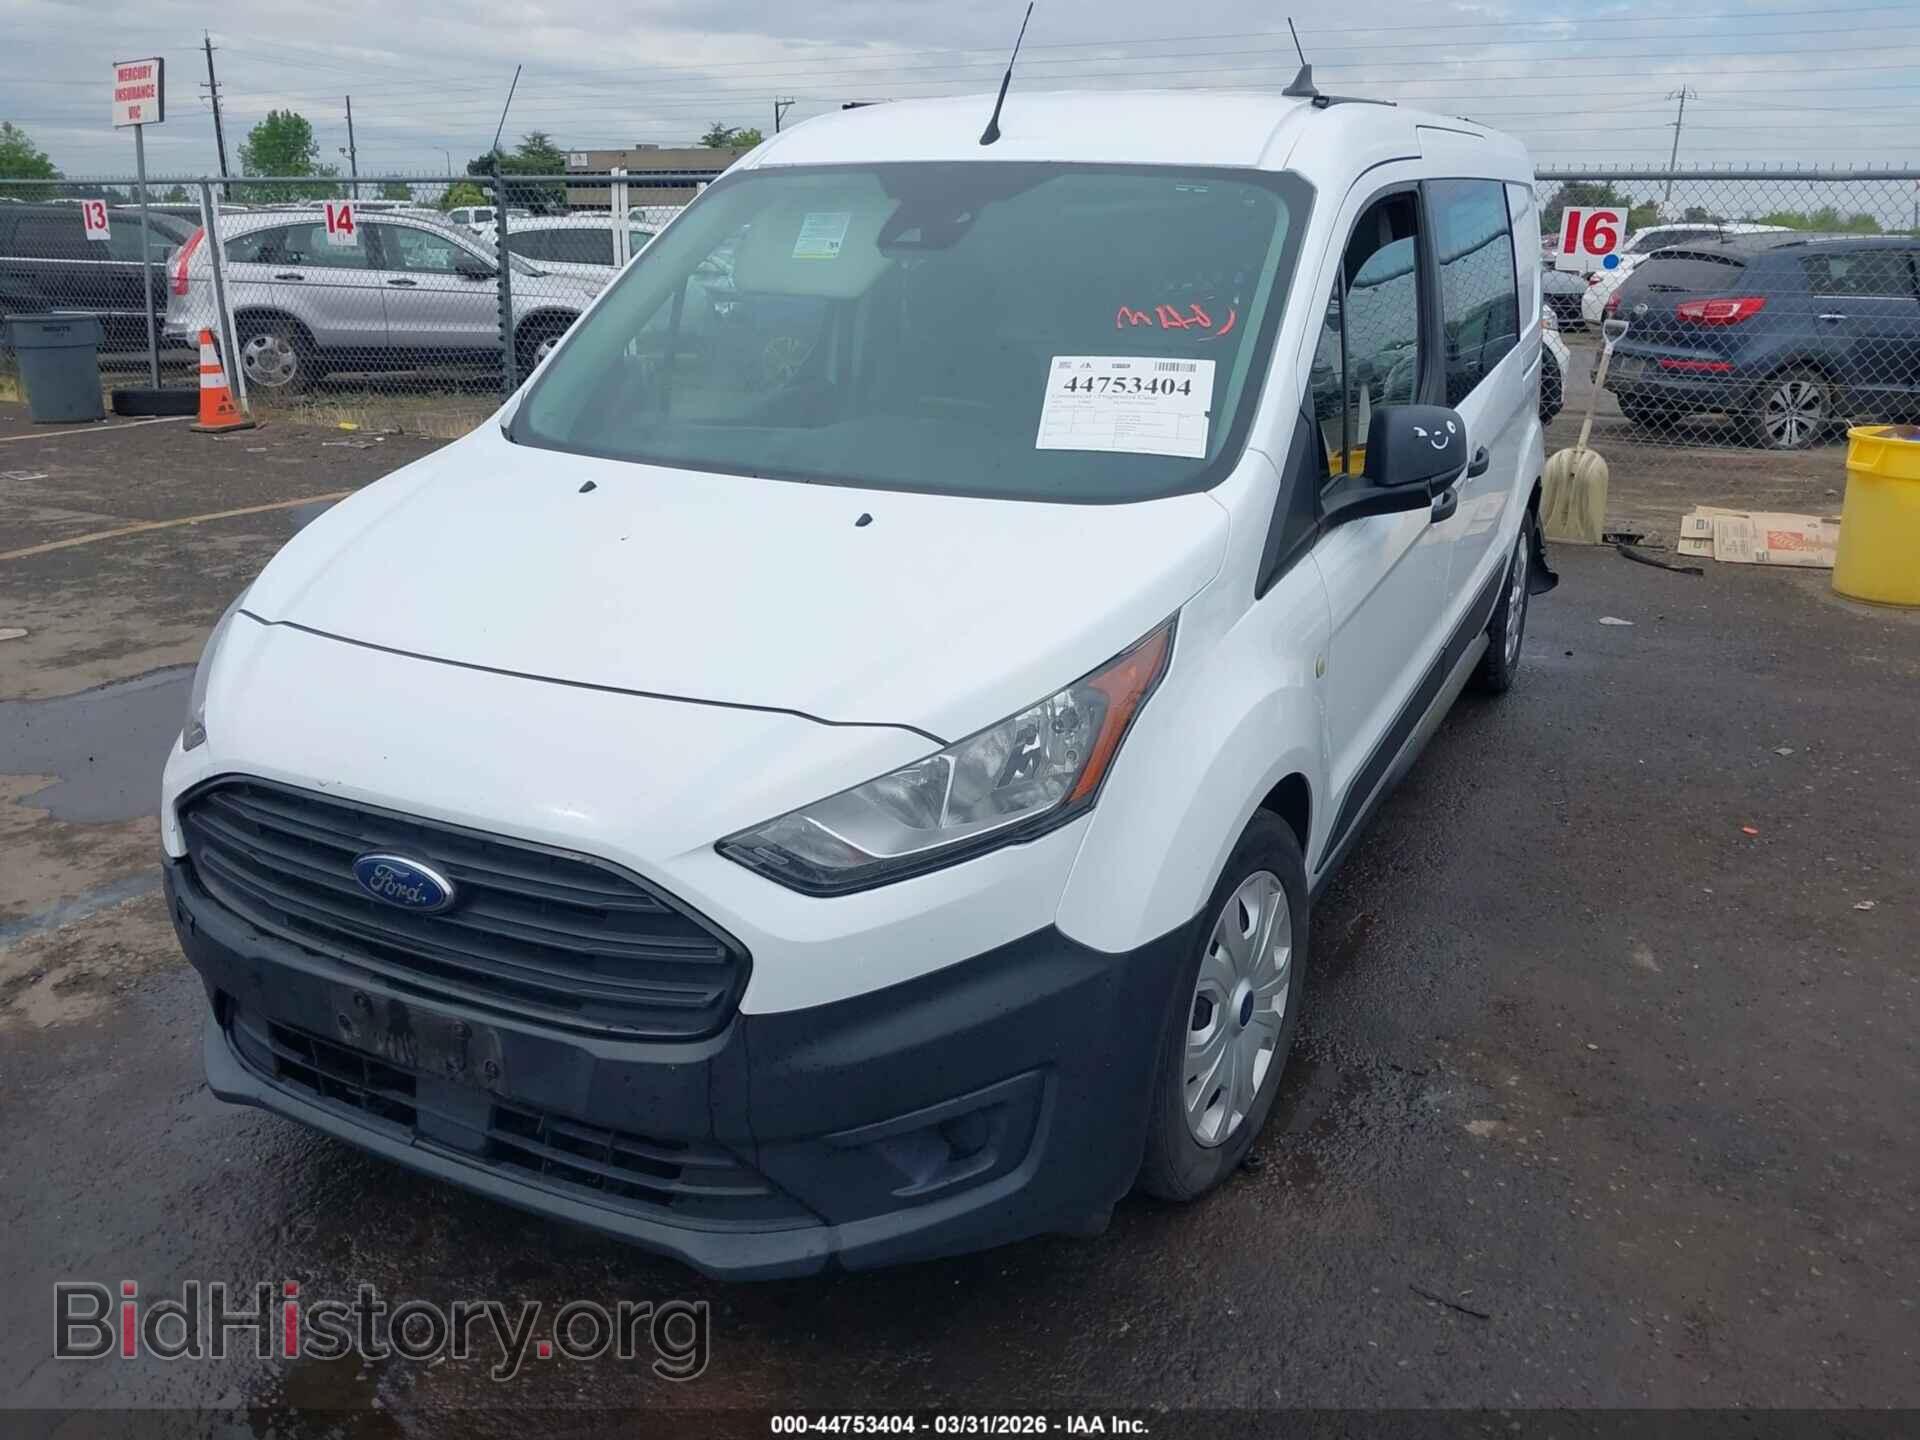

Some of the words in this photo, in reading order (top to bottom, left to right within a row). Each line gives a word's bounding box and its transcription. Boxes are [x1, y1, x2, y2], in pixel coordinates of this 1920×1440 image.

[117, 65, 153, 82] MERCURY
[115, 84, 155, 102] INSURANCE
[84, 202, 107, 230] 13
[326, 204, 354, 235] 14
[1563, 211, 1619, 256] 16
[1063, 376, 1191, 396] 44753404
[369, 864, 426, 903] Ford
